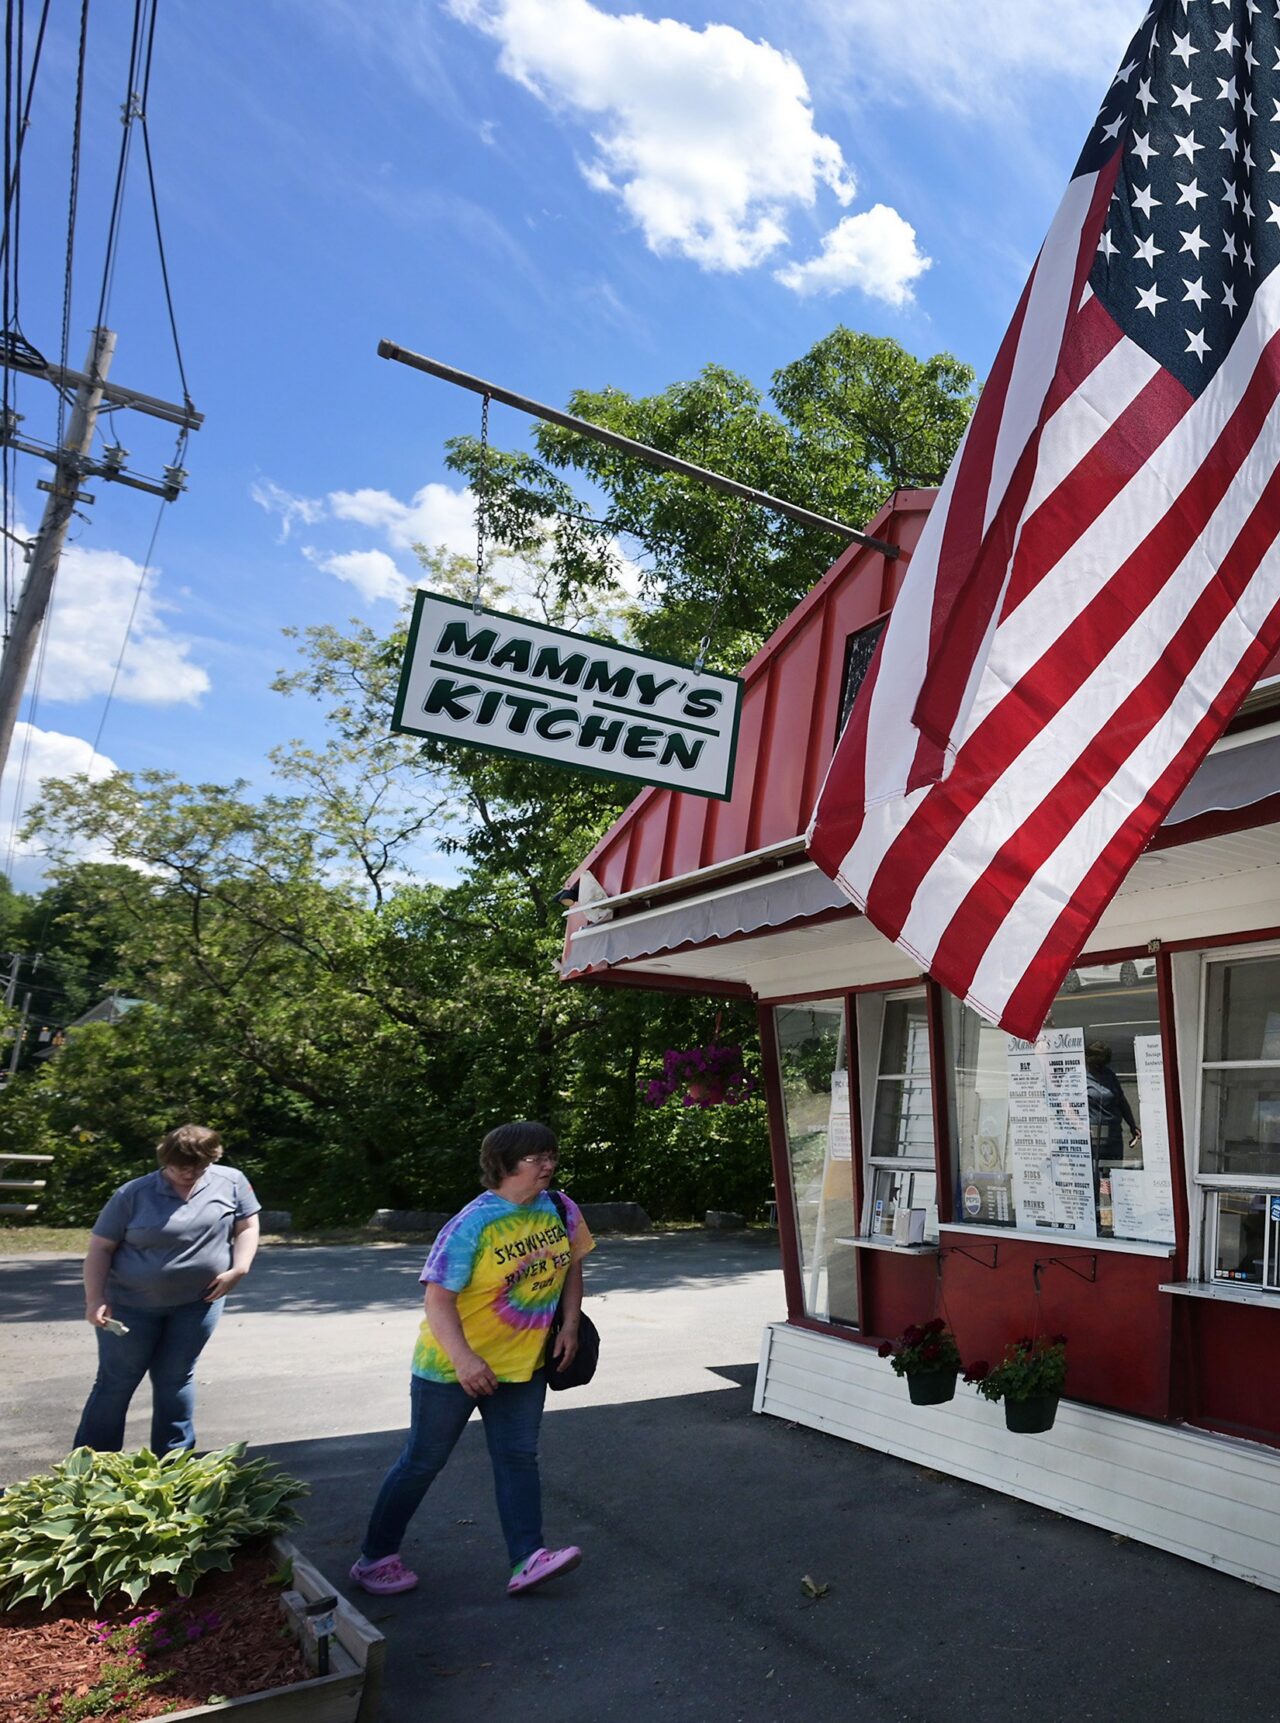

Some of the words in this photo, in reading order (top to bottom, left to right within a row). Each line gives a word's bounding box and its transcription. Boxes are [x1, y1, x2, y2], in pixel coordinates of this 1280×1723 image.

[435, 621, 723, 719] MAMMY'S
[422, 678, 706, 770] KITCHEN
[1023, 1171, 1041, 1179] SIDES
[1023, 1200, 1045, 1209] DRINKS
[494, 1225, 567, 1265] SKOWHEGA
[504, 1260, 547, 1287] RIVER
[552, 1252, 572, 1271] FES
